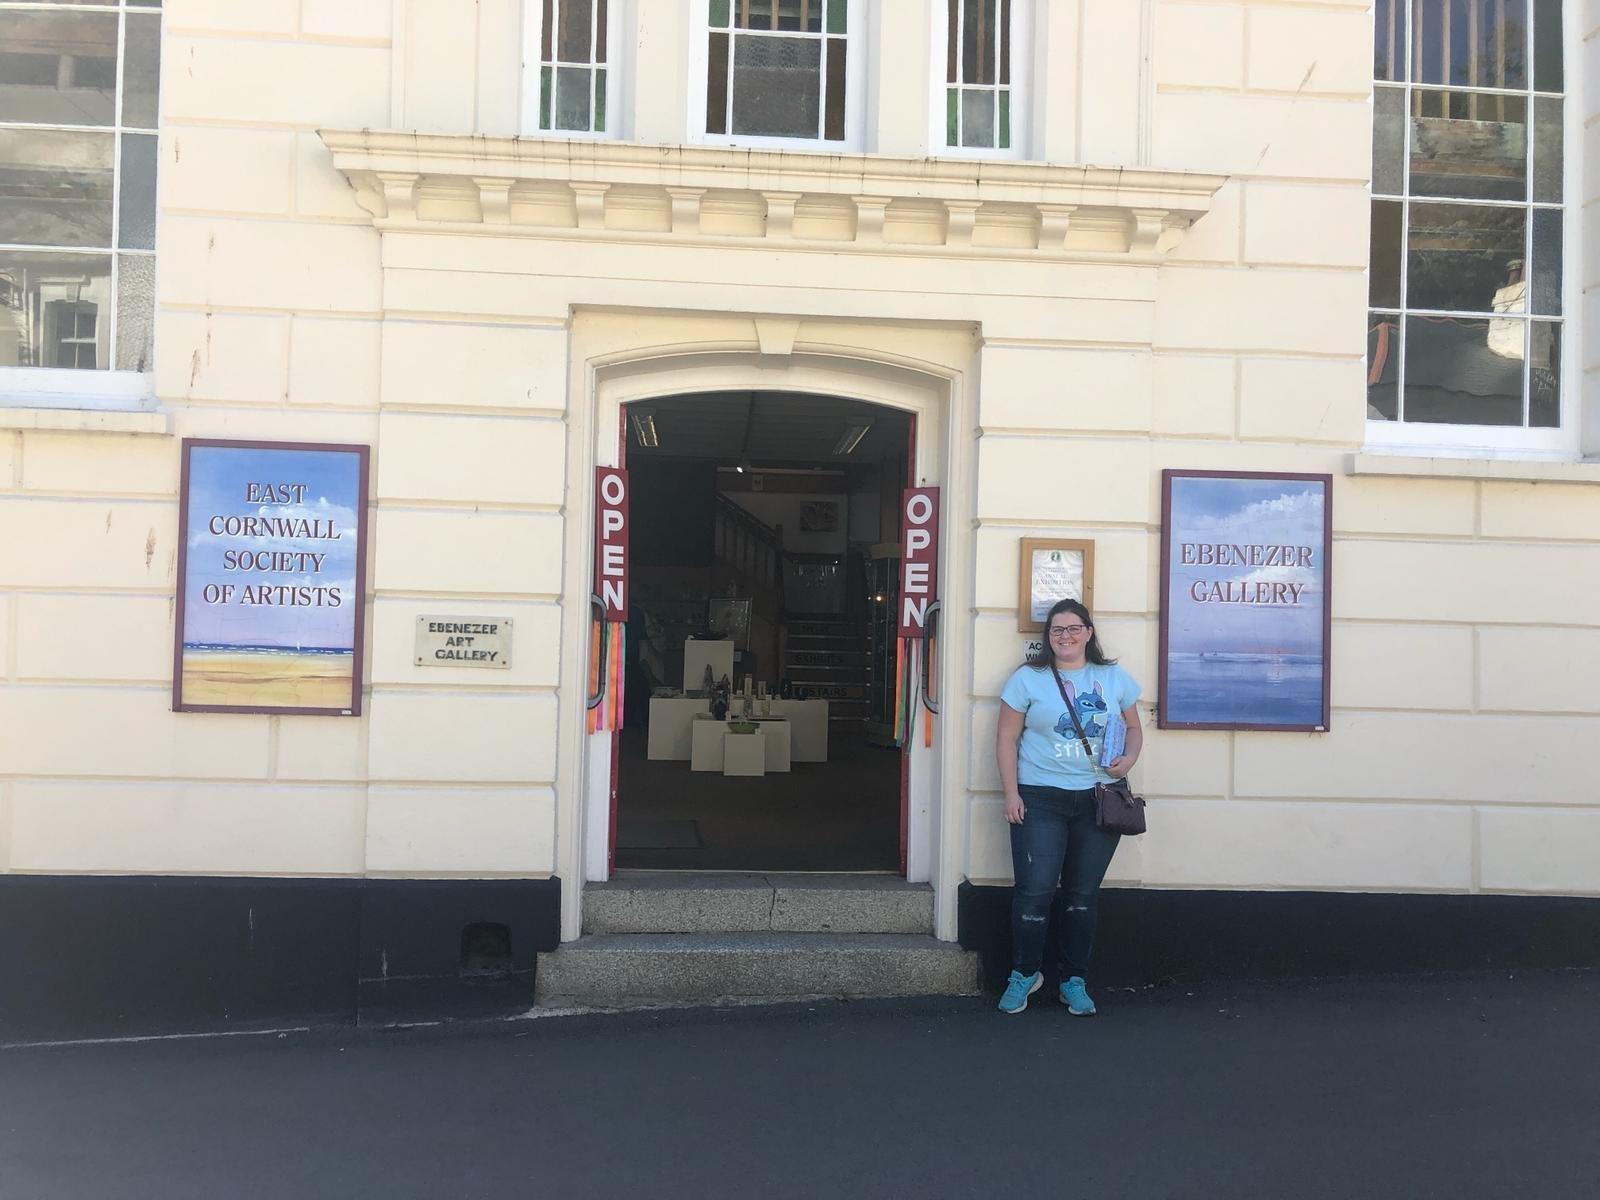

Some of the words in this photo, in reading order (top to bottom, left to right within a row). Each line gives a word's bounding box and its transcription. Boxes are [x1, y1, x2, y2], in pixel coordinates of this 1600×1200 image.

[247, 483, 307, 504] EAST
[209, 516, 341, 540] CORNWALL
[601, 474, 624, 611] OPEN
[223, 550, 326, 573] SOCIETY
[903, 494, 933, 628] OPEN
[1180, 543, 1314, 569] EBENEZER
[203, 584, 235, 604] OF
[240, 585, 342, 608] ARTISTS
[1191, 581, 1304, 604] GALLERY
[428, 622, 498, 635] EBENEZER
[445, 636, 475, 647] ART
[1028, 642, 1042, 651] AC
[434, 649, 498, 662] GALLERY
